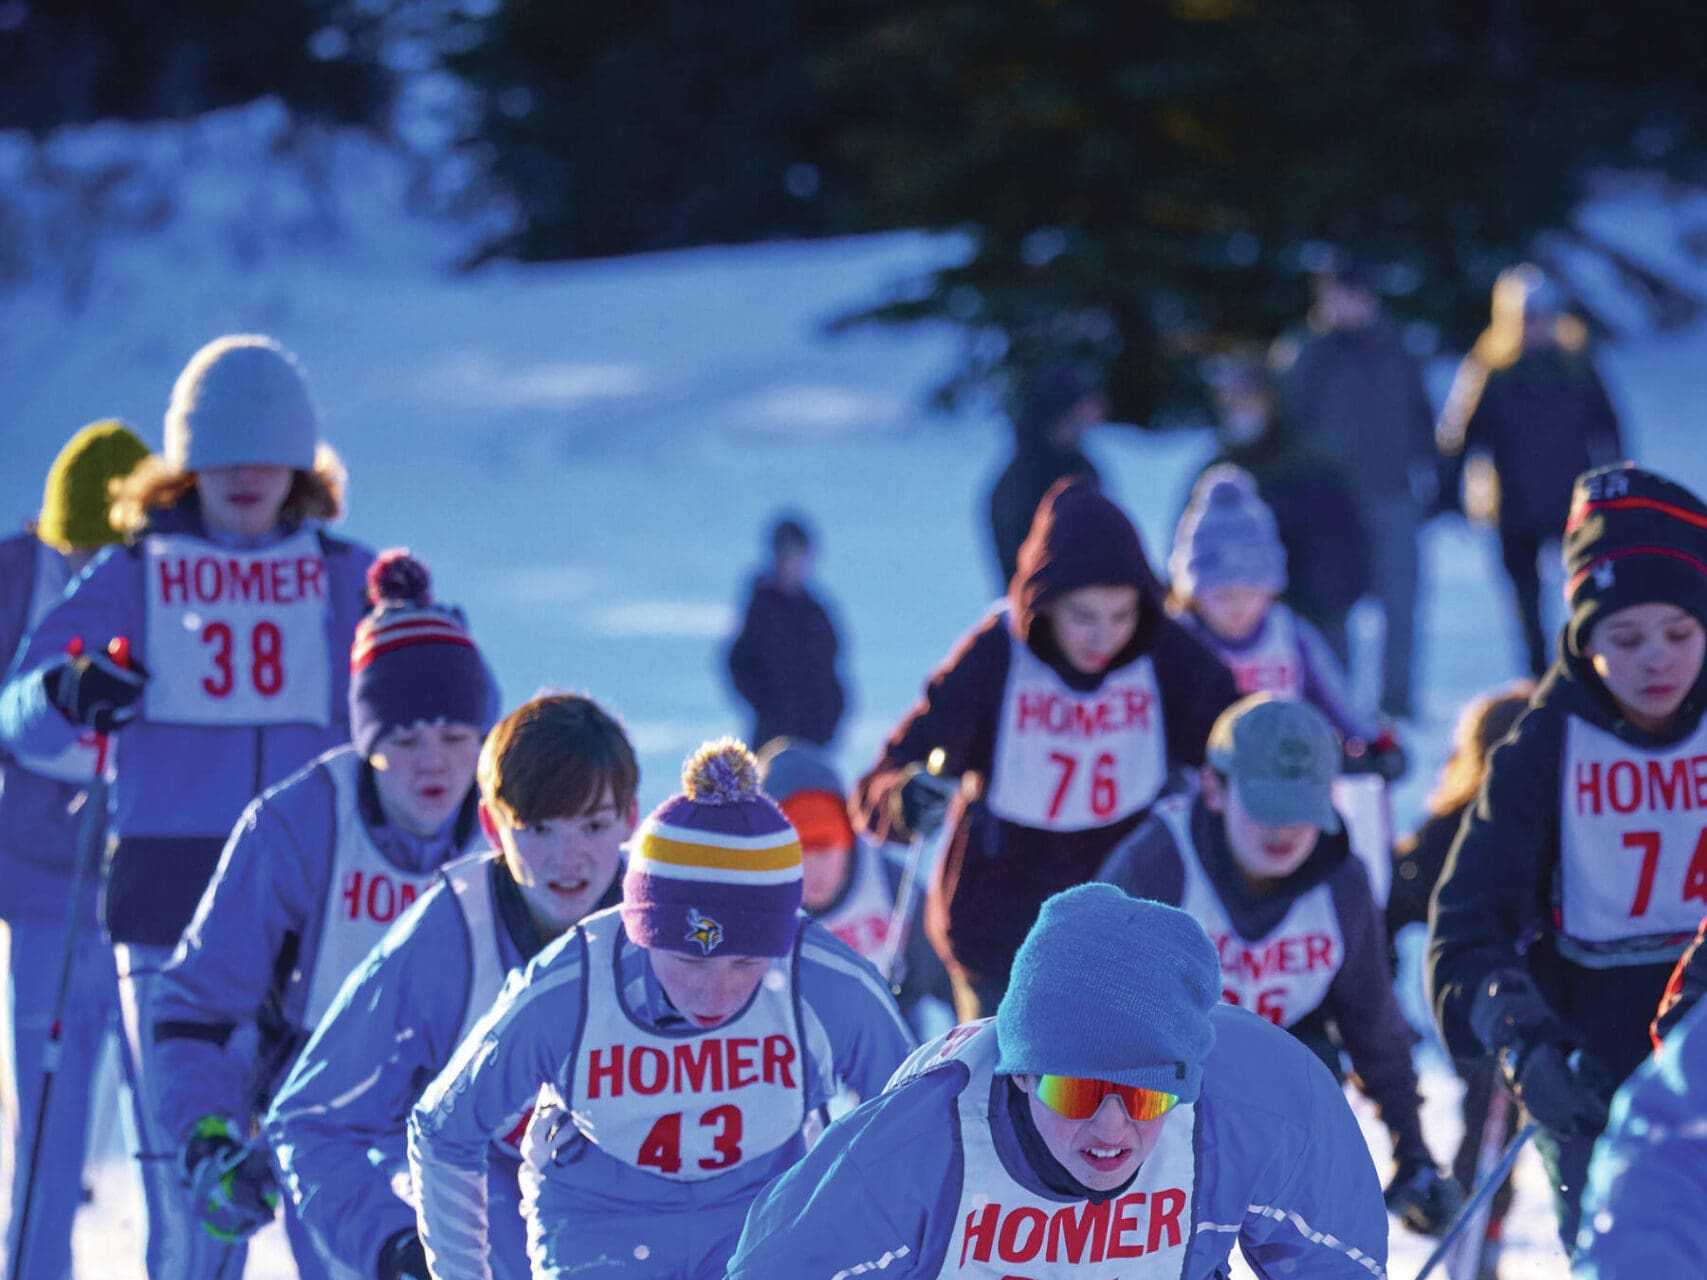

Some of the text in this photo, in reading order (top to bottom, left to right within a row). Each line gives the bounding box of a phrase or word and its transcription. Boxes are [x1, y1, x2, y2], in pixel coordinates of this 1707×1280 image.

[160, 559, 324, 604] HOMER
[202, 621, 283, 697] 38
[1017, 689, 1153, 737] HOMER
[1047, 751, 1118, 820] 76
[1622, 825, 1707, 925] 74
[587, 1034, 796, 1099] HOMER
[637, 1104, 743, 1173] 43
[959, 1187, 1187, 1269] HOMER
